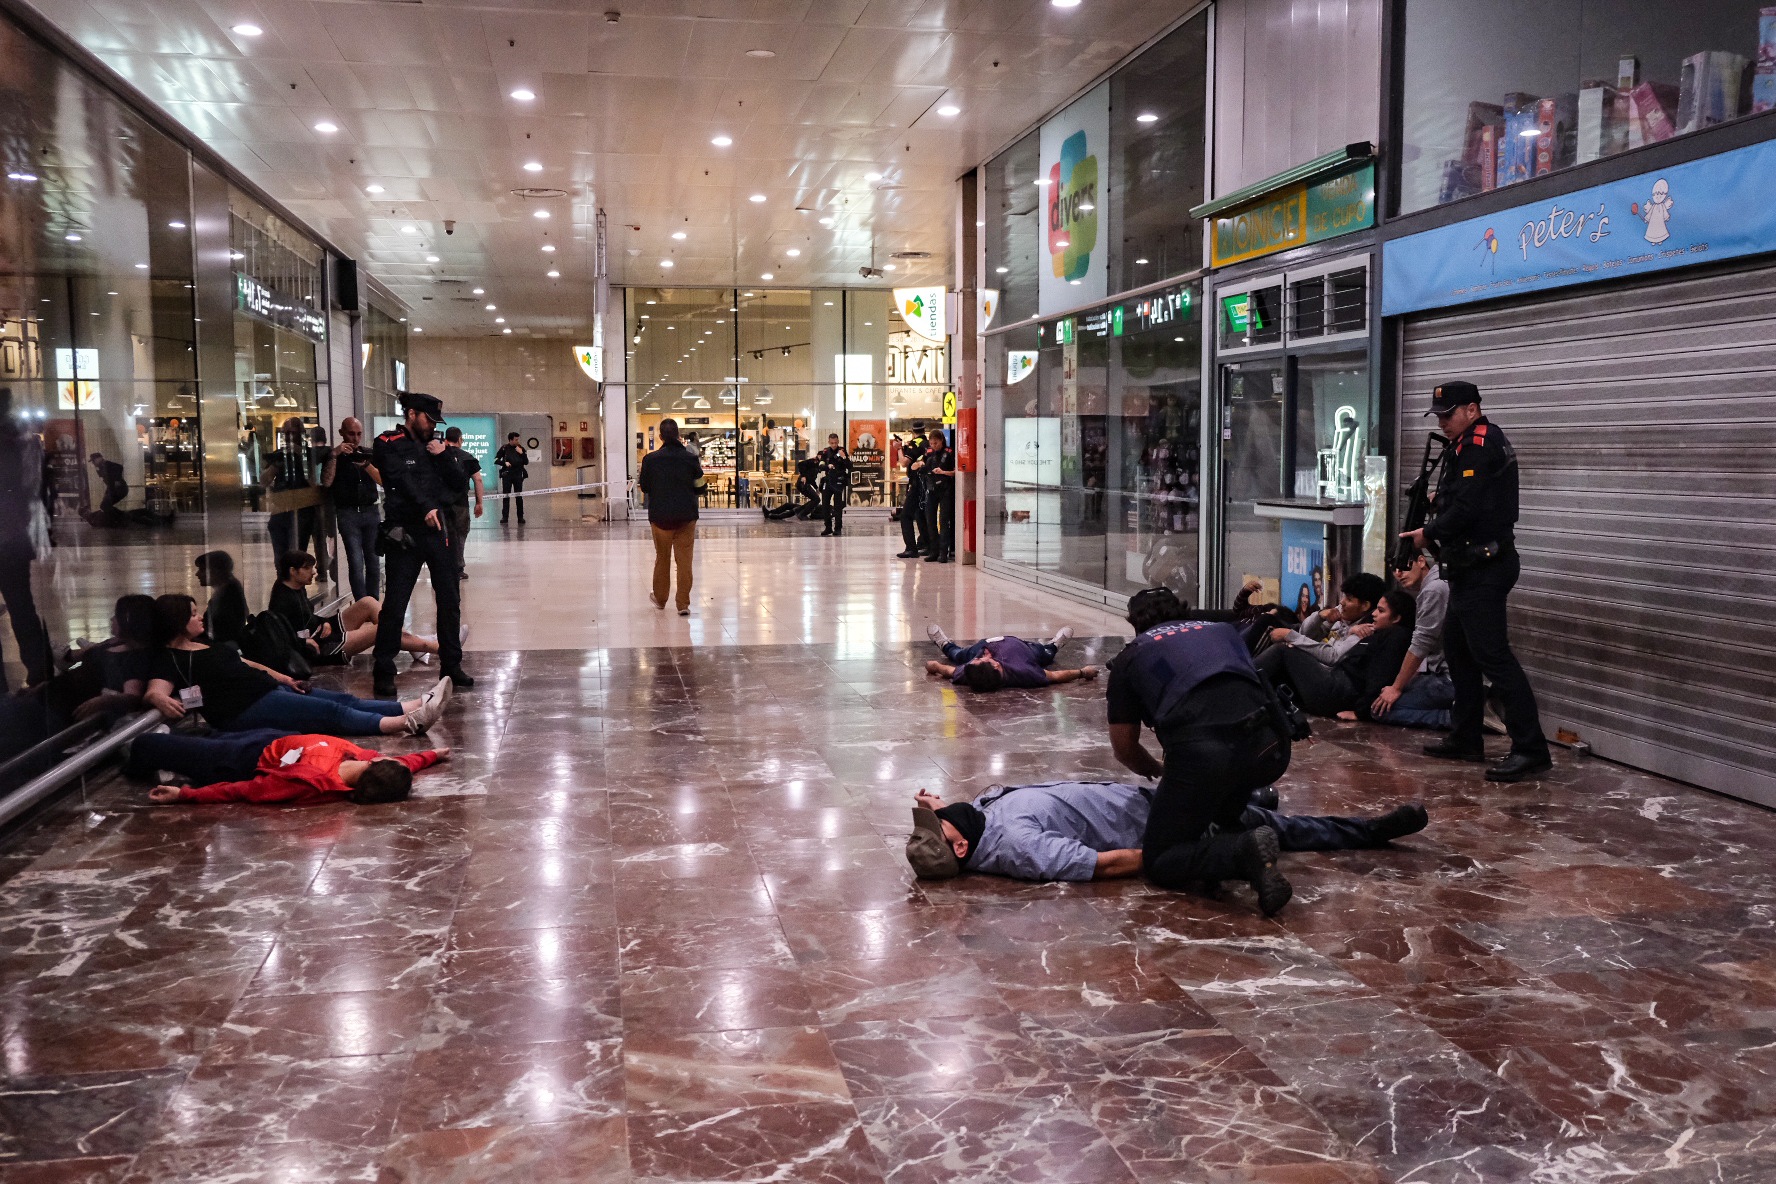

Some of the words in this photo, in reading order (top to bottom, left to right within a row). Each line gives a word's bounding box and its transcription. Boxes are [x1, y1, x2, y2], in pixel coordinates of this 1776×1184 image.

[1313, 211, 1329, 232] DE
[929, 292, 937, 337] tiendas
[475, 447, 488, 455] just
